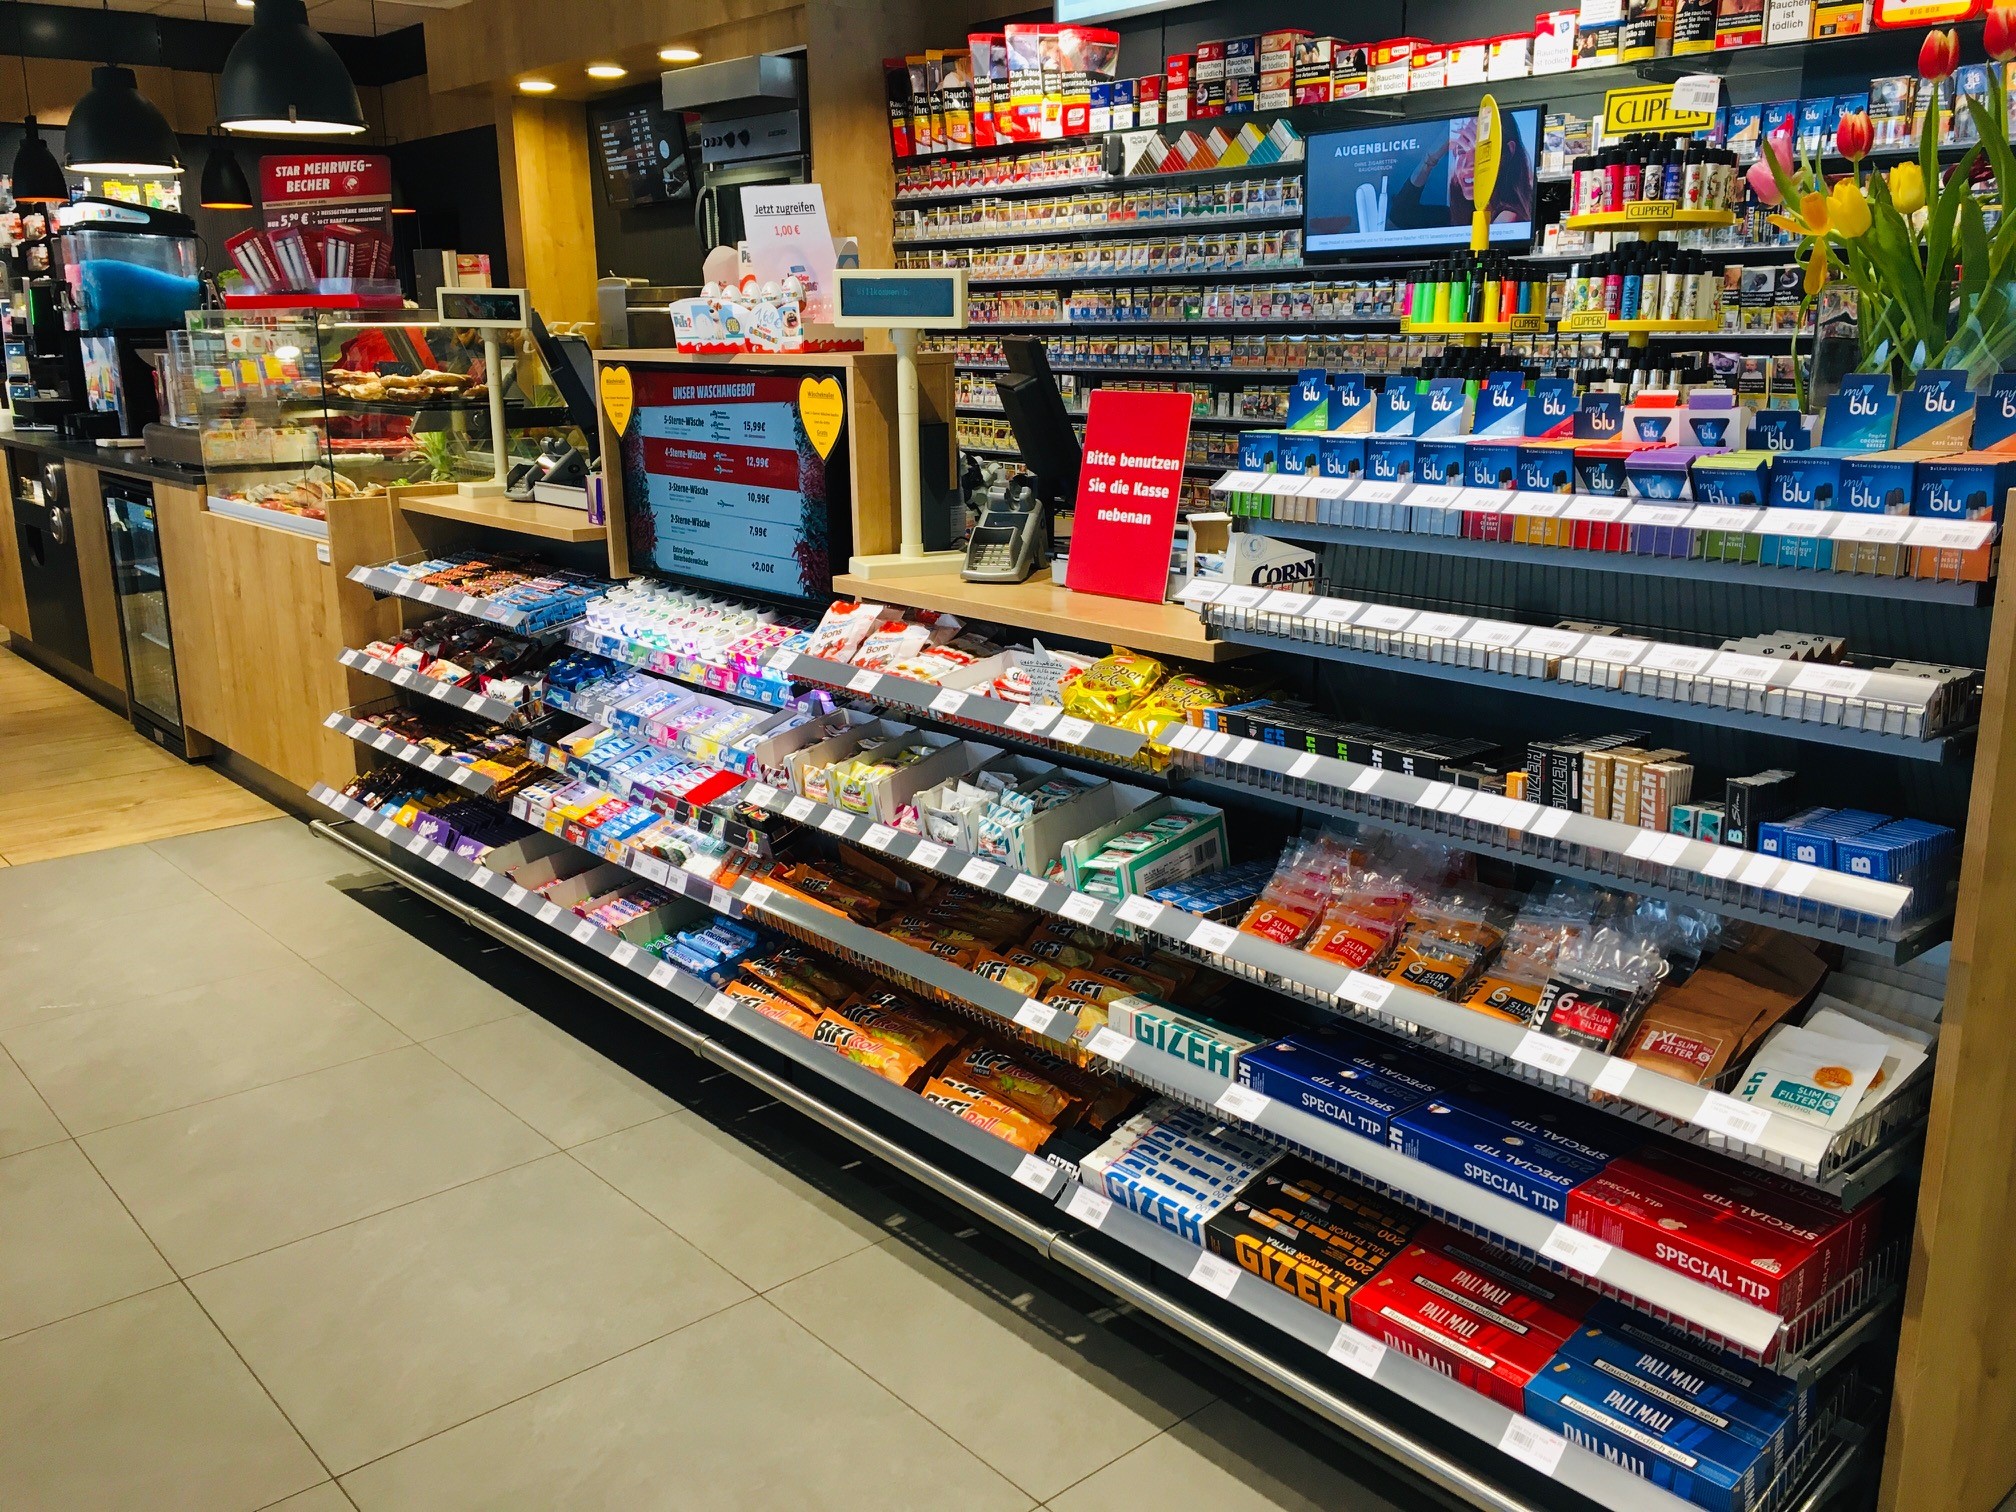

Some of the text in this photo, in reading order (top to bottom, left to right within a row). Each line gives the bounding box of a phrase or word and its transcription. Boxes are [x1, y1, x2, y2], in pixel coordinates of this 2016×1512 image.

[1782, 10, 1794, 19] ist
[1910, 6, 1940, 16] BIG BOX
[1772, 19, 1804, 31] tödlich
[1198, 62, 1222, 70] Rauchen
[1227, 58, 1251, 67] Rauchen
[1262, 53, 1286, 62] Rauchen
[1377, 72, 1404, 82] Rauchen
[1261, 91, 1286, 100] Rauchen
[1335, 139, 1420, 158] AUGENBLICKE.
[276, 160, 372, 178] STAR MEHRWEG-
[286, 178, 330, 193] BECHER
[755, 202, 815, 215] Jetzt zugreifen
[1630, 205, 1673, 218] CLIPPER
[774, 225, 800, 236] 1,00 €
[1512, 317, 1539, 328] CLIPPER
[1573, 317, 1604, 327] CLIPPER
[673, 383, 755, 400] UNSER WASCHANGEBOT
[1342, 391, 1360, 407] blu
[1431, 395, 1452, 412] blu
[1543, 398, 1566, 416] blu
[1925, 392, 1955, 412] blu
[743, 421, 766, 432] 15,99€
[1643, 426, 1658, 438] blu
[1768, 432, 1794, 450] blu
[746, 456, 769, 468] 12,99€
[1086, 450, 1180, 471] Bitte benutzen
[1285, 456, 1302, 471] blu
[1375, 460, 1394, 477] blu
[1475, 467, 1496, 485] blu
[1592, 472, 1615, 490] blu
[1088, 478, 1170, 498] Sie die Kasse
[747, 492, 770, 504] 10,99€
[1851, 487, 1880, 509] blu
[1097, 507, 1152, 525] nebenan
[749, 525, 767, 537] 7,99€
[751, 561, 774, 573] +2,00€
[822, 627, 842, 639] Bons
[866, 643, 889, 654] Bons
[1259, 909, 1278, 923] 6
[1272, 920, 1295, 934] SLIM
[1331, 930, 1350, 945] 6
[1340, 946, 1362, 963] FILTER
[1344, 940, 1368, 956] SLIM
[1408, 961, 1428, 976] 6
[1419, 978, 1444, 990] FILTER
[1424, 972, 1449, 983] SLIM
[1491, 986, 1512, 1003] 6
[1509, 1001, 1534, 1016] SLIM
[1574, 1004, 1612, 1025] XL SLIM
[1580, 1019, 1609, 1034] FILTER
[850, 1034, 882, 1053] Roll
[1135, 1013, 1234, 1078] GIZEH
[1657, 1030, 1698, 1051] XL SLIM
[1658, 1044, 1693, 1059] FILTER
[1778, 1089, 1815, 1108] FILTER
[1797, 1086, 1822, 1098] SLIM
[1301, 1092, 1382, 1136] SPECIAL TIP
[1778, 1101, 1812, 1115] MENTHOL
[962, 1109, 1002, 1131] Roll
[1046, 1154, 1082, 1180] GIZEH
[1464, 1162, 1559, 1211] SPECIAL TIP
[1596, 1178, 1663, 1208] SPECIAL TIP
[1212, 1190, 1229, 1201] 100
[1106, 1171, 1204, 1248] GIZEH
[1702, 1193, 1819, 1240] SPECIAL TIP
[1377, 1229, 1406, 1246] 200
[1266, 1236, 1358, 1288] FULL FLAVOR EXTRA
[1345, 1258, 1375, 1275] 200
[1235, 1234, 1351, 1323] GIZEH
[1655, 1242, 1770, 1300] SPECIAL TIP
[1451, 1270, 1511, 1306] PALL MALL
[1421, 1278, 1520, 1331] Rauchen kann tödlich sein
[1419, 1301, 1480, 1339] PALL MALL
[1635, 1353, 1706, 1395] PALL MALL
[1601, 1362, 1719, 1424] Rauchen kann tödlich sein
[1603, 1389, 1674, 1433] PALL MALL
[1569, 1398, 1688, 1464] Rauchen kann tödlich sein
